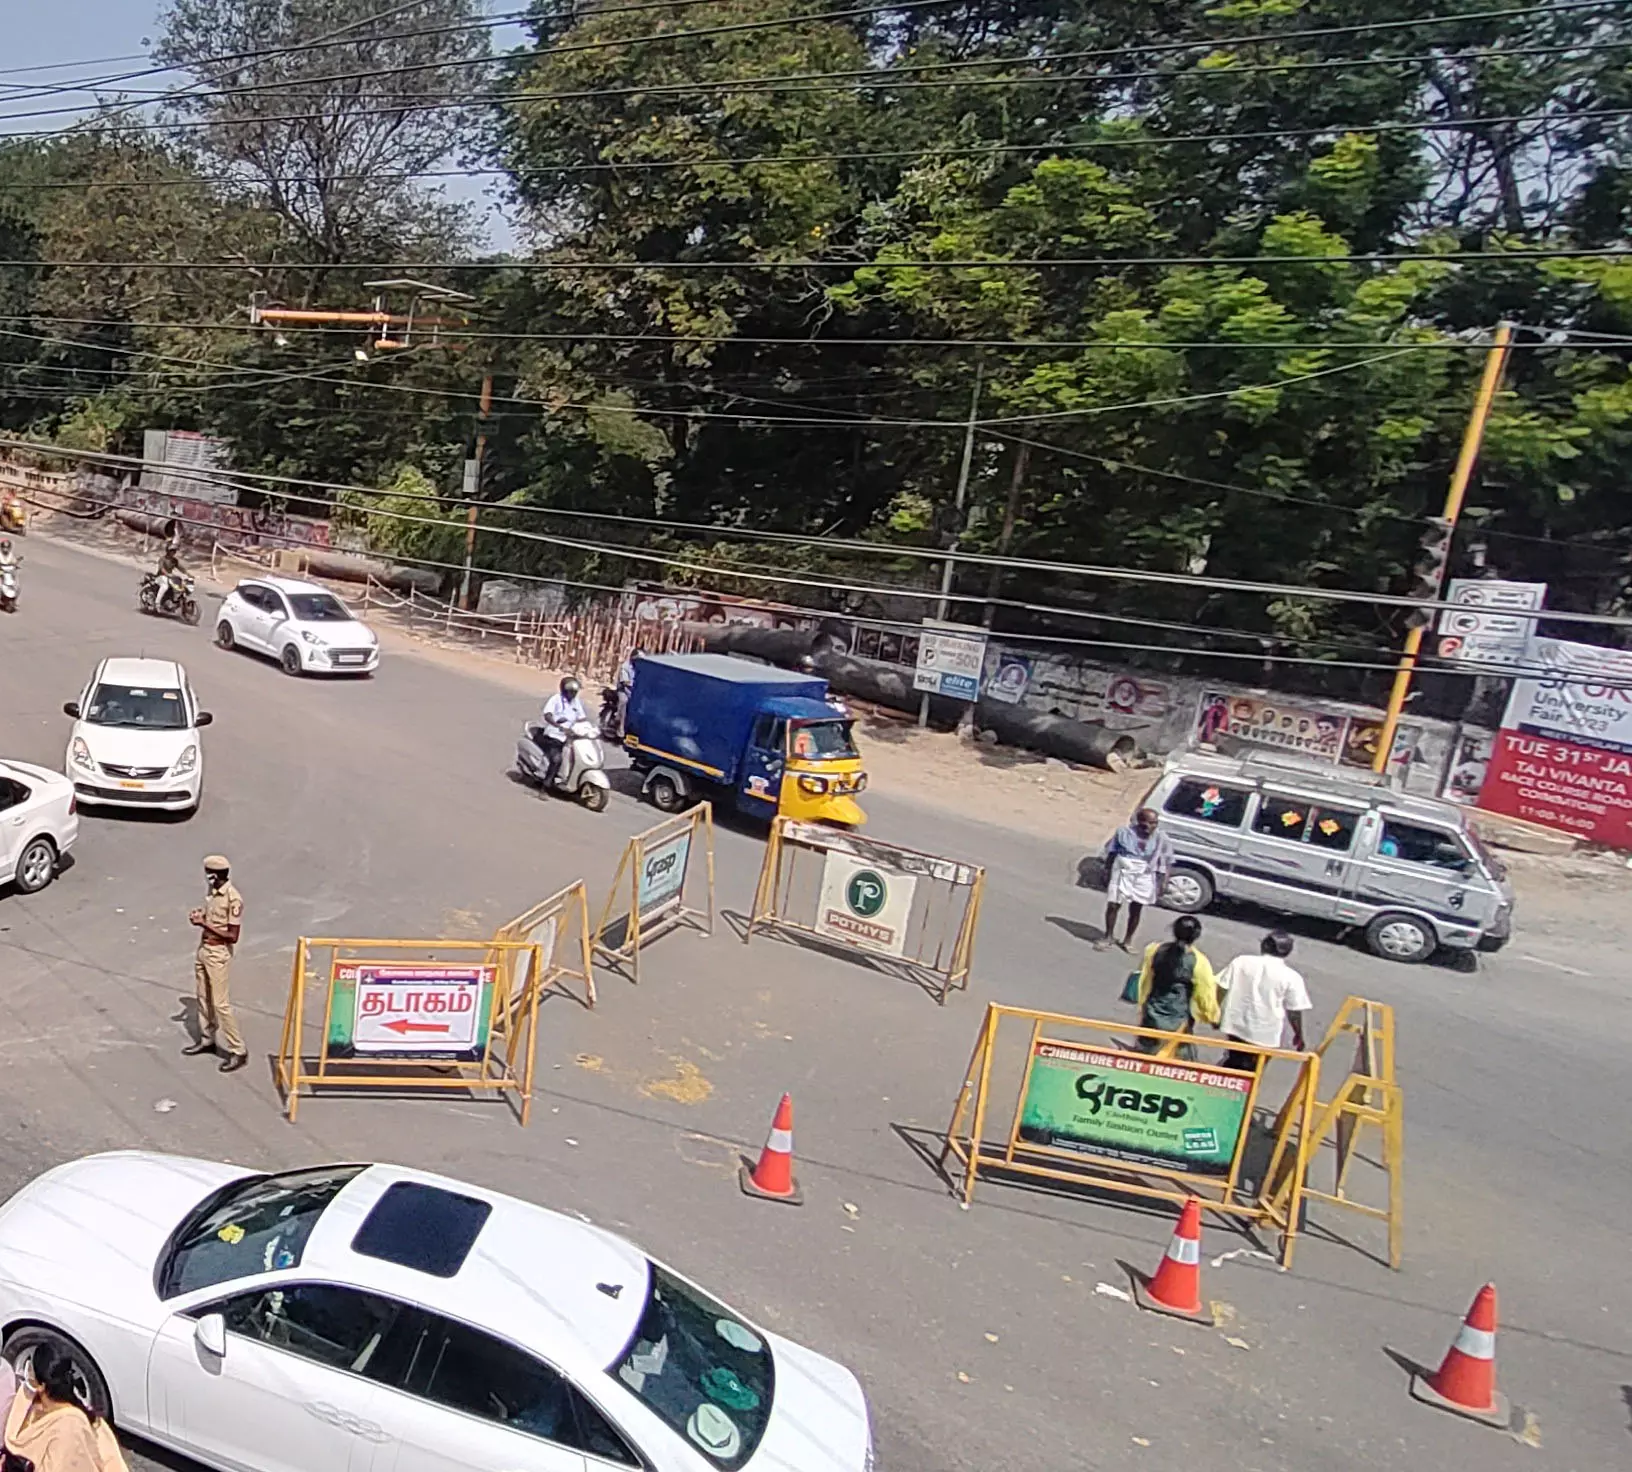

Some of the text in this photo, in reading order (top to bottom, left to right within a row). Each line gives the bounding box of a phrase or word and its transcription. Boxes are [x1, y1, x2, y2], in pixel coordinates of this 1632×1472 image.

[1530, 705, 1562, 721] Fair
[1505, 736, 1550, 758] TUE
[1516, 760, 1627, 795] TAJ VIVANTA
[829, 913, 891, 941] POTHYS
[360, 984, 473, 1020] தடாகம்
[1116, 1057, 1144, 1073] CITY
[1148, 1063, 1199, 1082] TRAFFIC
[1199, 1072, 1245, 1091] POLICE
